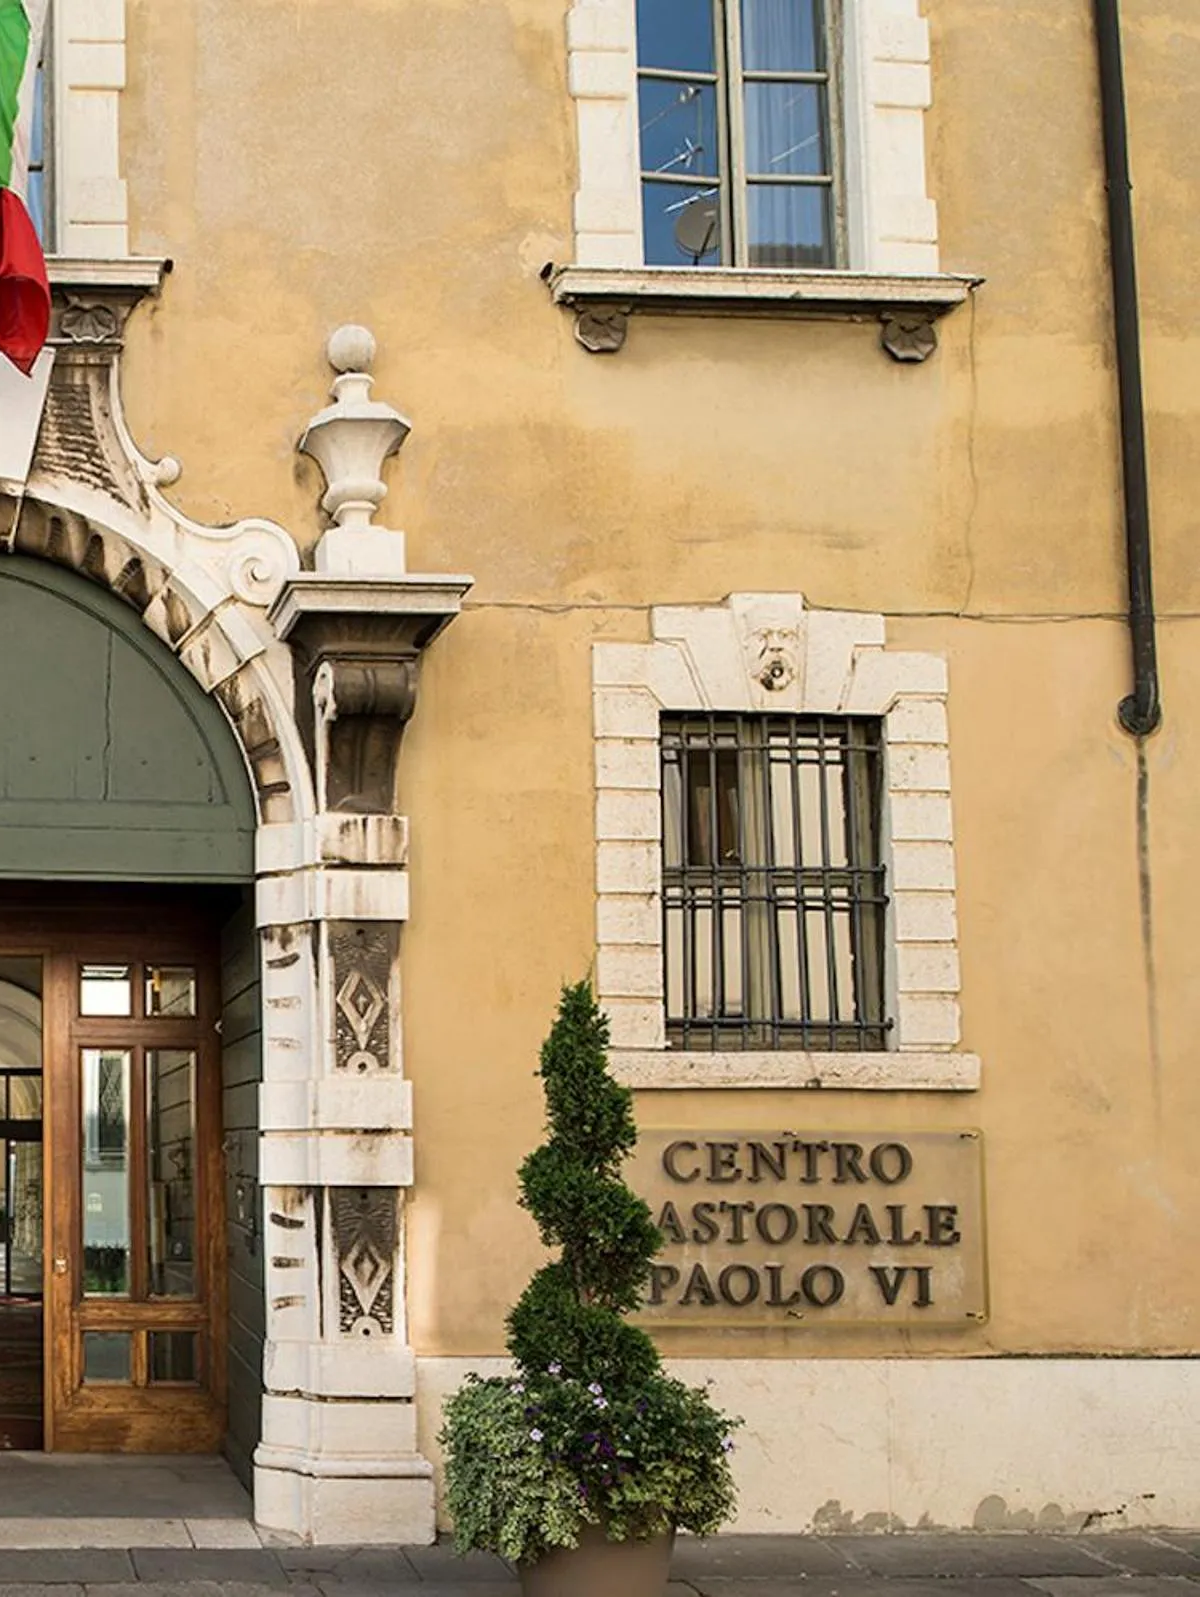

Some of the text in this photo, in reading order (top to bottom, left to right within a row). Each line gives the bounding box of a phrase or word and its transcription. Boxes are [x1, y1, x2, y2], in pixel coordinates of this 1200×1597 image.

[662, 1140, 913, 1184] CENTRO
[657, 1201, 961, 1246] ASTORALE
[650, 1263, 934, 1307] PAOLO VI
